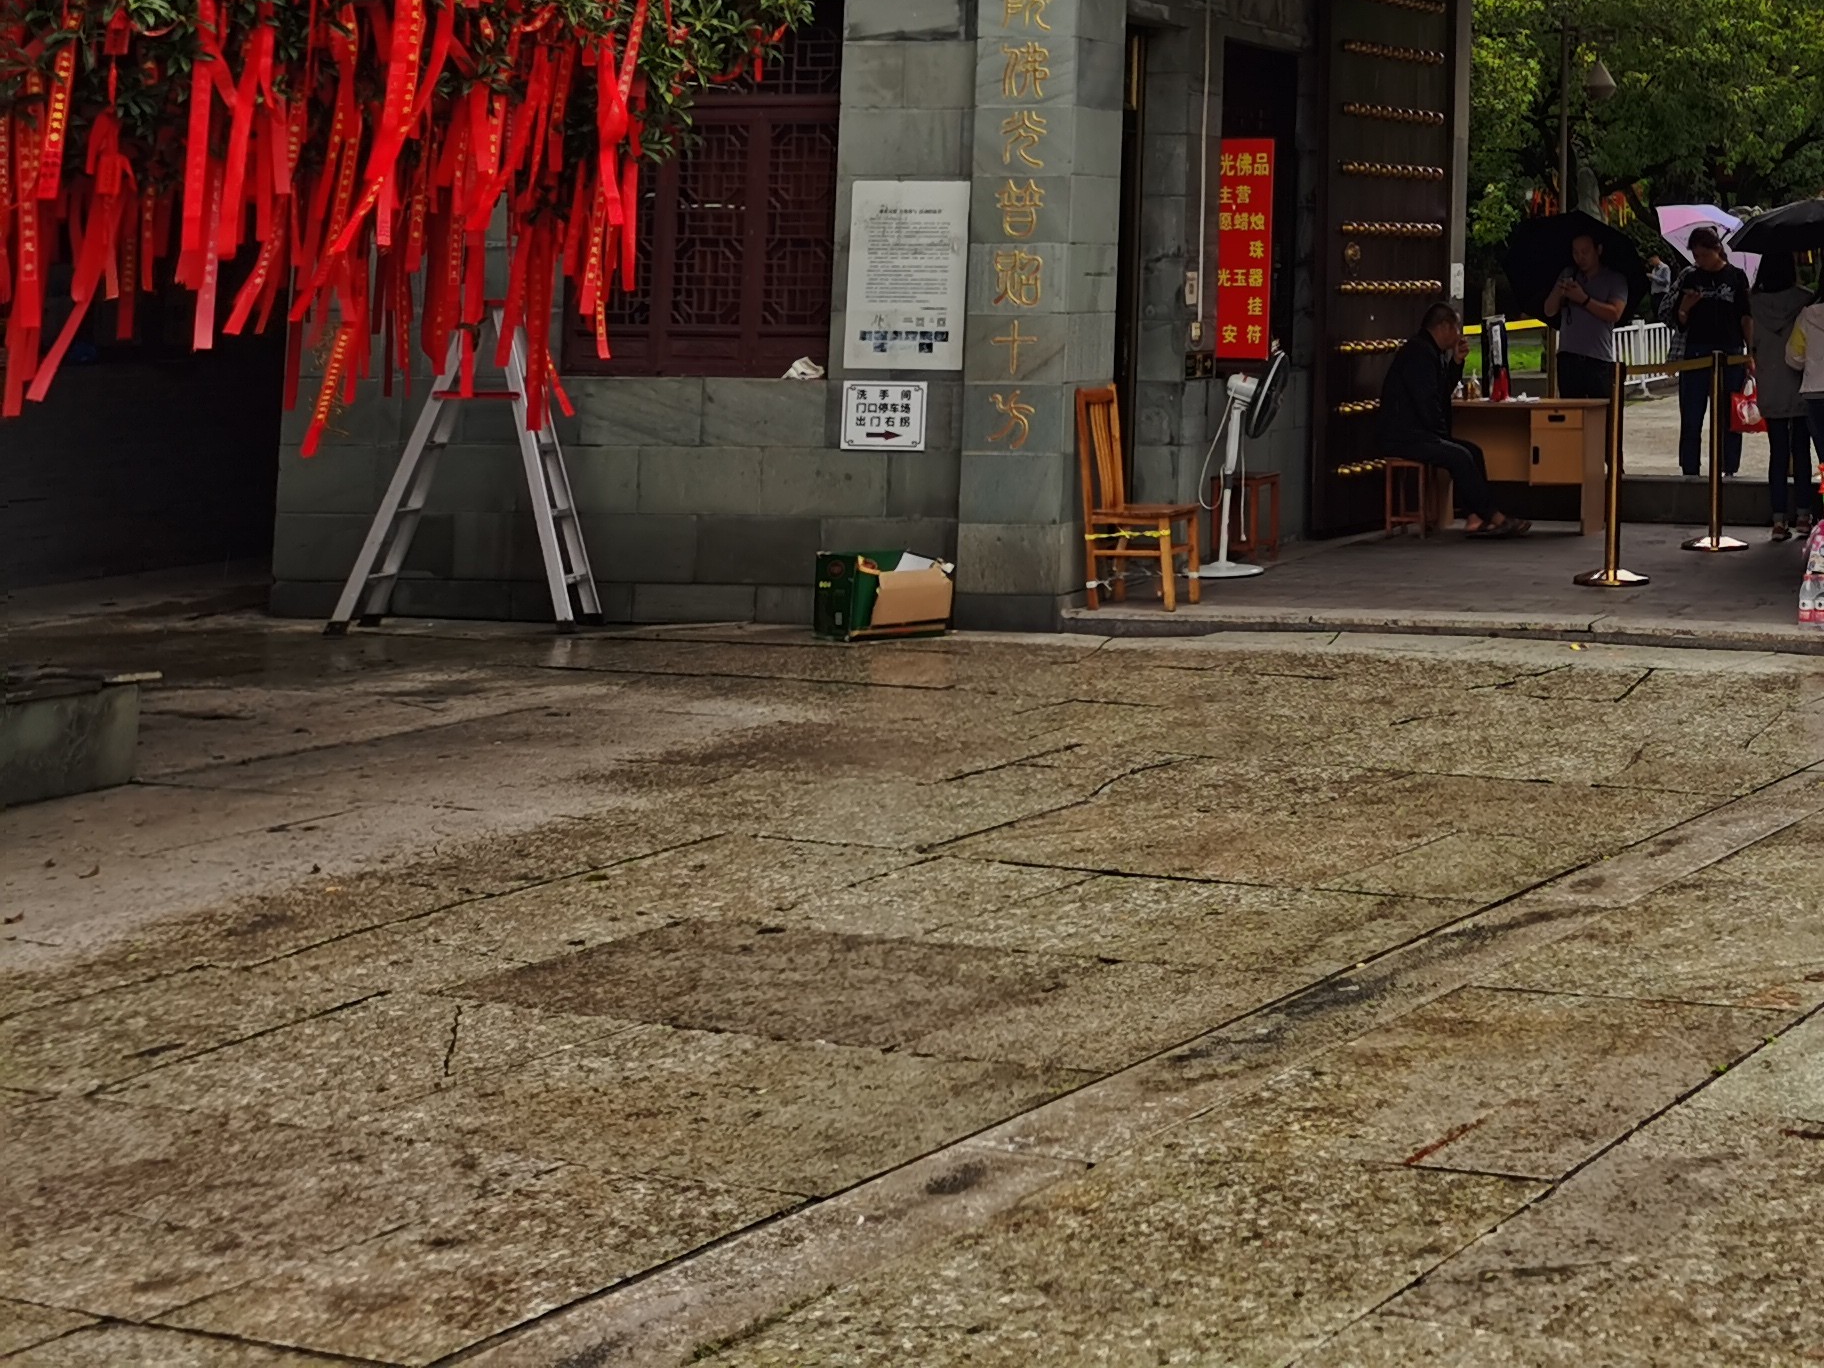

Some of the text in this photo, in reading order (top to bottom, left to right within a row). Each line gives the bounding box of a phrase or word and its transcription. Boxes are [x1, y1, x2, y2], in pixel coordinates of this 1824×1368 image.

[1219, 185, 1251, 205] 主营
[1249, 240, 1264, 259] 珠
[1217, 268, 1264, 288] 光玉器
[1247, 296, 1263, 316] 挂
[856, 388, 912, 401] 洗手间
[855, 401, 911, 415] 门口停车场
[855, 415, 911, 429] 出门右拐
